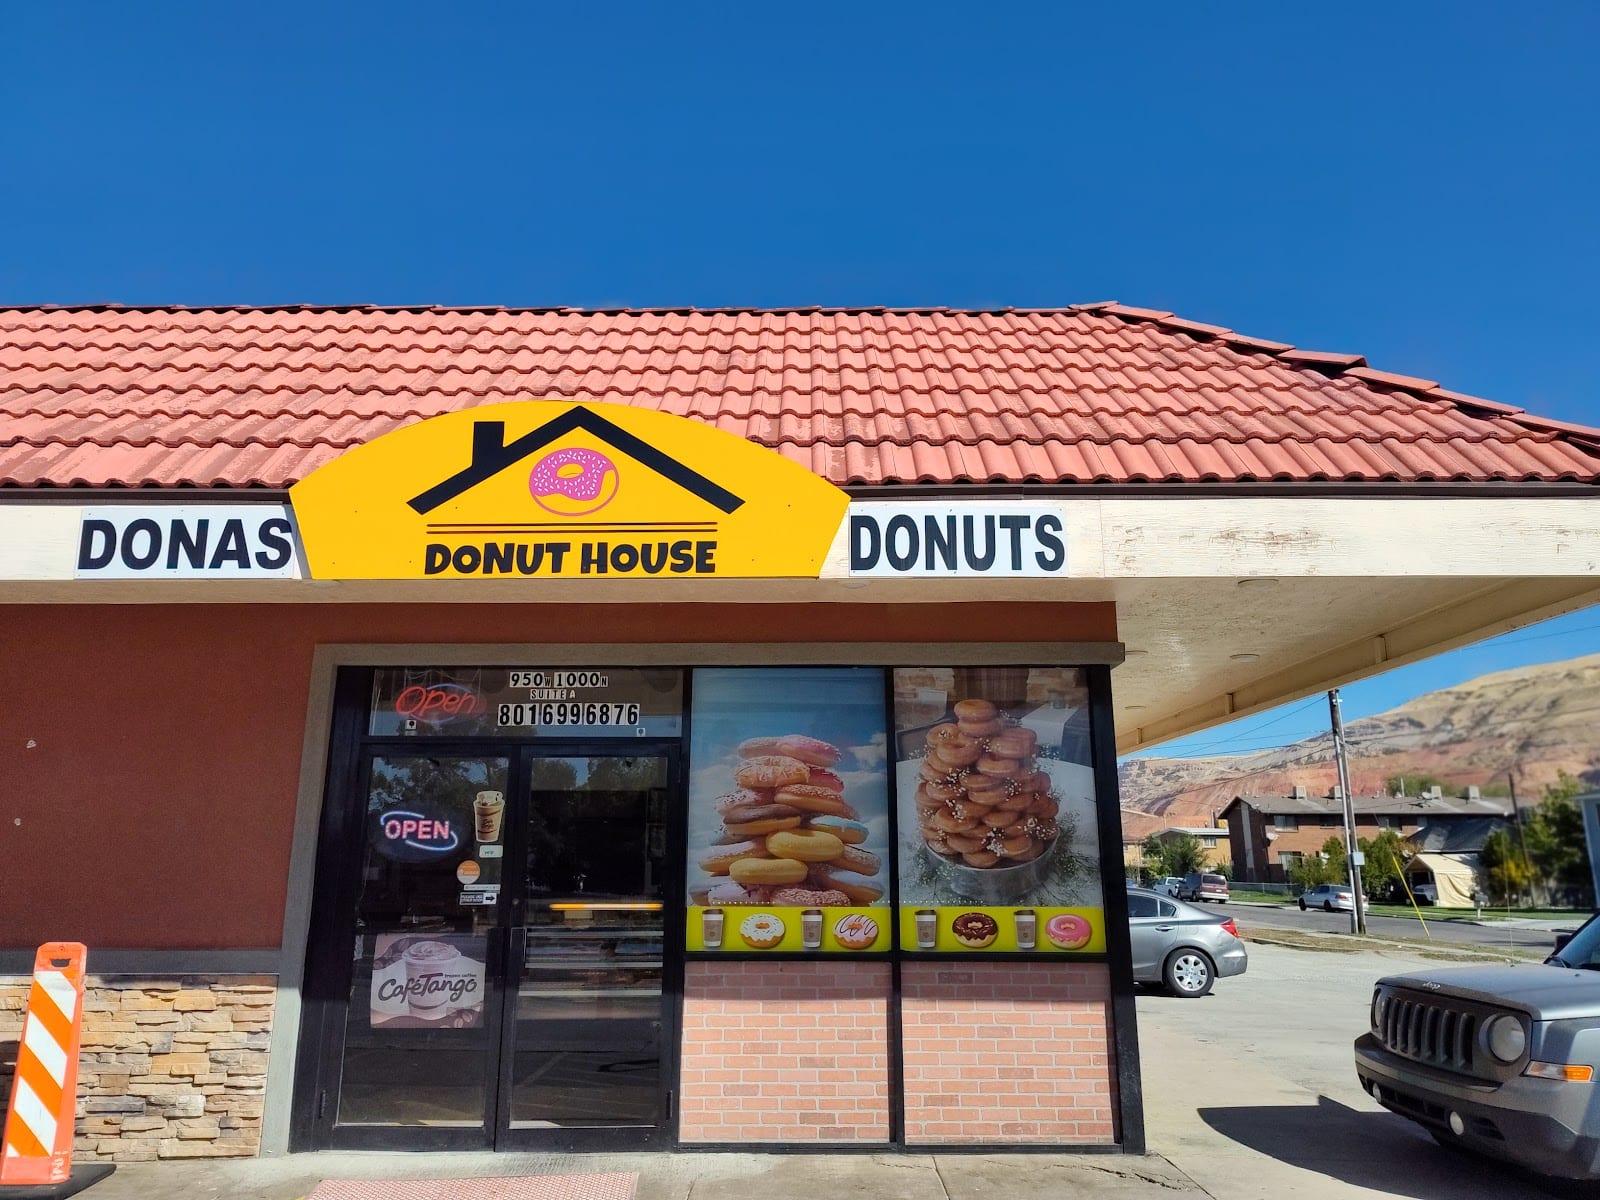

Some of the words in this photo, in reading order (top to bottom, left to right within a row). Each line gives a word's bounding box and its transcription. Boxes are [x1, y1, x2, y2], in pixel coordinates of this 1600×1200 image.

[78, 518, 293, 570] DONAS
[424, 542, 571, 575] DONUT
[580, 540, 718, 574] HOUSE
[850, 514, 1066, 572] DONUTS
[395, 686, 478, 717] Open
[531, 689, 566, 699] SUITE
[385, 819, 450, 840] OPEN
